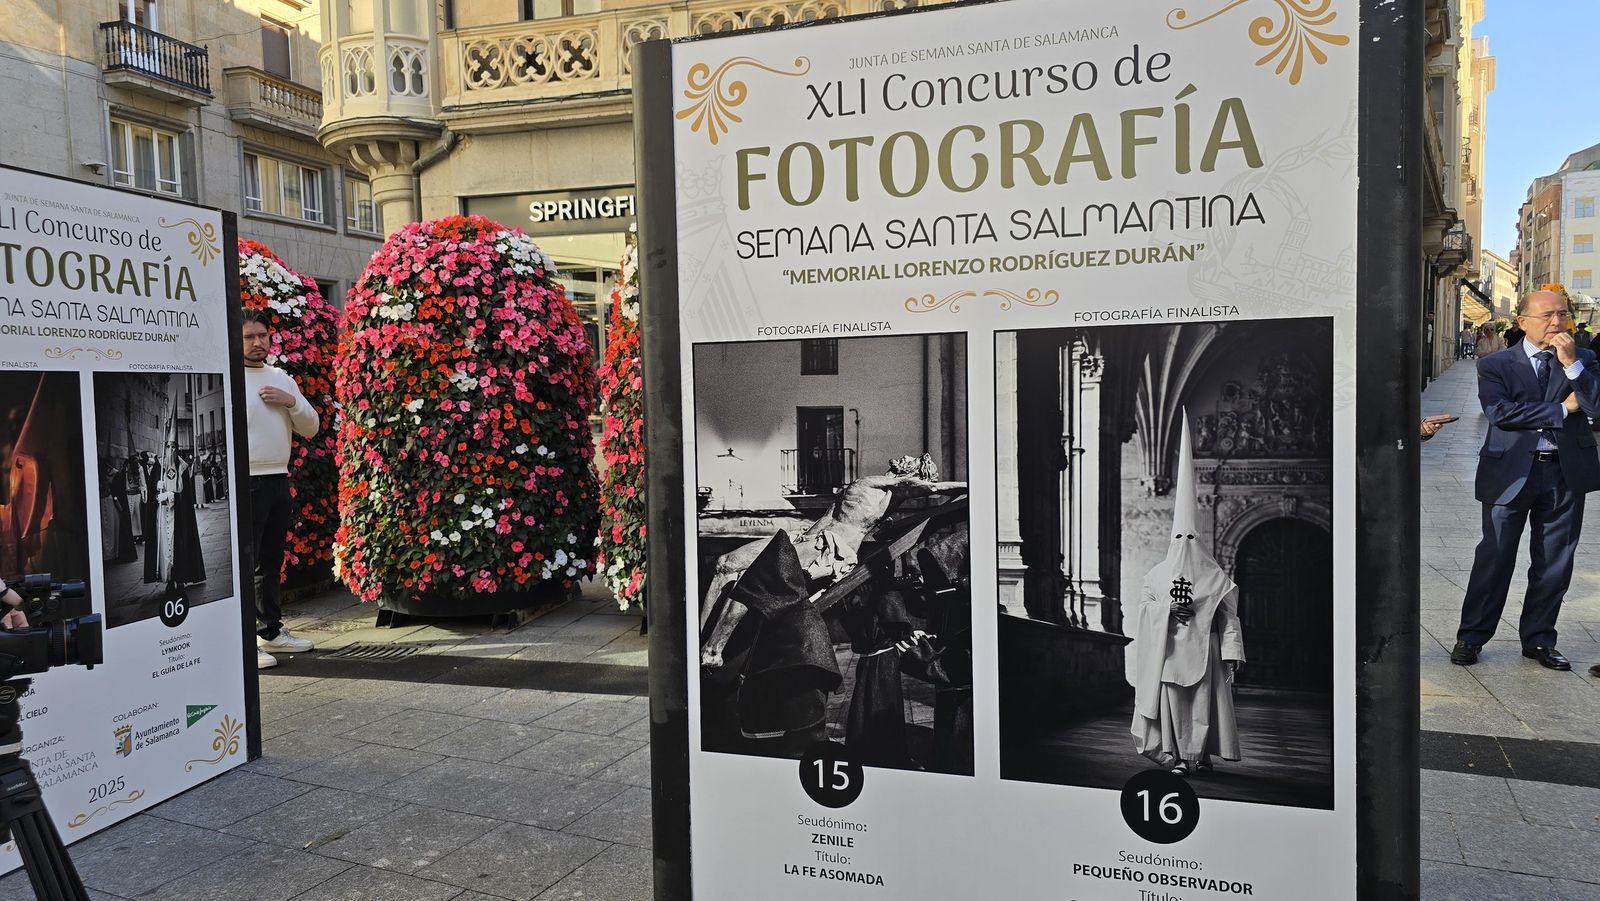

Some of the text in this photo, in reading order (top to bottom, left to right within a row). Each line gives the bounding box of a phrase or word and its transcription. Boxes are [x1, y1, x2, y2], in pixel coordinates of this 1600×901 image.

[849, 25, 1119, 70] JUNTA DE SEMANA SANTA DE SALAMANCA
[806, 43, 1172, 121] XLI Concurso de
[736, 83, 1264, 211] FOTOGRAFÍA
[4, 192, 141, 224] JUNTA DE SEMANA SANTA DE SALAMANCA
[529, 195, 635, 222] SPRINGFI
[25, 210, 133, 248] Concurso
[139, 229, 162, 251] de
[737, 192, 1266, 260] SEMANA SANTA SALMANTINA
[894, 257, 985, 279] LORENZO
[989, 249, 1111, 273] RODRÍGUEZ
[31, 299, 93, 321] SANTA
[97, 304, 200, 329] SALMANTINA
[1074, 305, 1240, 322] FOTOGRAFÍA FINALISTA
[38, 326, 87, 339] LORENZO
[88, 329, 144, 342] RODRÍGUEZ
[757, 321, 892, 336] FOTOGRAFÍA FINALISTA
[1, 361, 38, 369] FINALISTA
[164, 598, 184, 618] 06
[159, 632, 193, 647] Seudónimo:
[161, 641, 191, 656] LYMKOOK
[152, 657, 201, 679] EL GUÍA DE LA FE
[26, 706, 48, 719] CIELO
[112, 702, 160, 722] COLABORAN:
[134, 718, 180, 740] Ayuntamiento
[135, 727, 180, 751] de Salamanca
[54, 749, 69, 761] DE
[65, 751, 96, 768] SANTA
[813, 759, 850, 791] 15
[88, 776, 125, 803] 2025
[1136, 789, 1183, 825] 16
[797, 814, 867, 832] Seudónimo:
[811, 833, 854, 848] ZENILE
[815, 849, 851, 865] Título:
[1118, 850, 1203, 871] Seudónimo:
[784, 863, 885, 886] LA FE ASOMADA
[1072, 863, 1253, 896] PEQUEÑO OBSERVADOR
